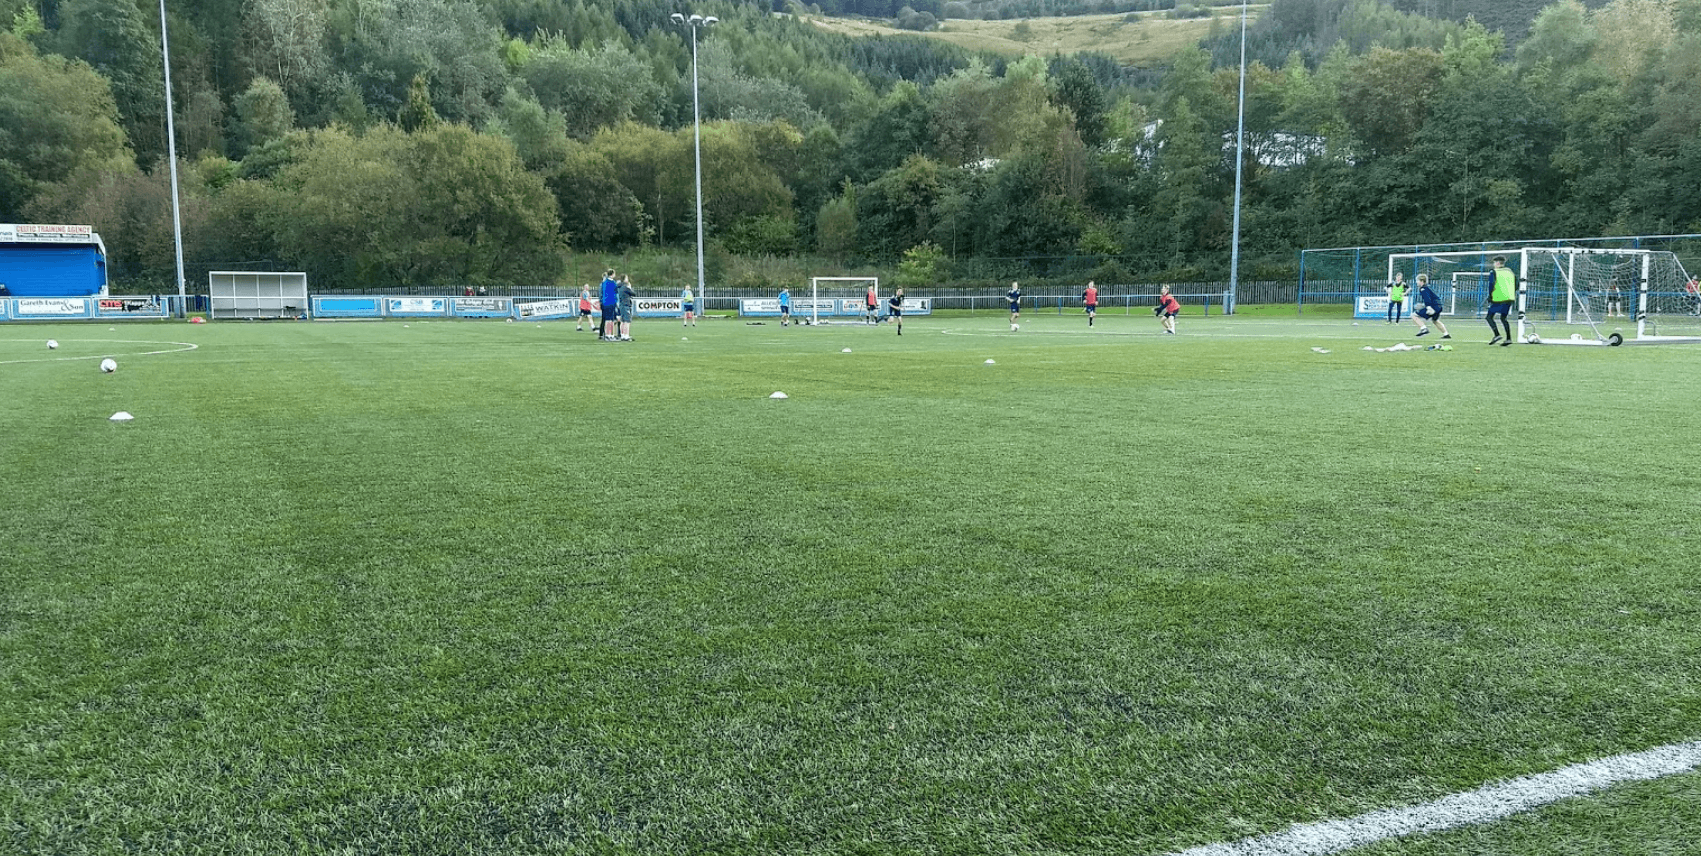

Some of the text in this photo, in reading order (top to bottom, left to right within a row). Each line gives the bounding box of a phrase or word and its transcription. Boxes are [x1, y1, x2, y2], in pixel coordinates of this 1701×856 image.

[37, 225, 66, 233] TRAINING
[67, 226, 90, 234] AGENCY
[535, 302, 569, 312] WATKIN
[638, 301, 680, 310] COMPTON
